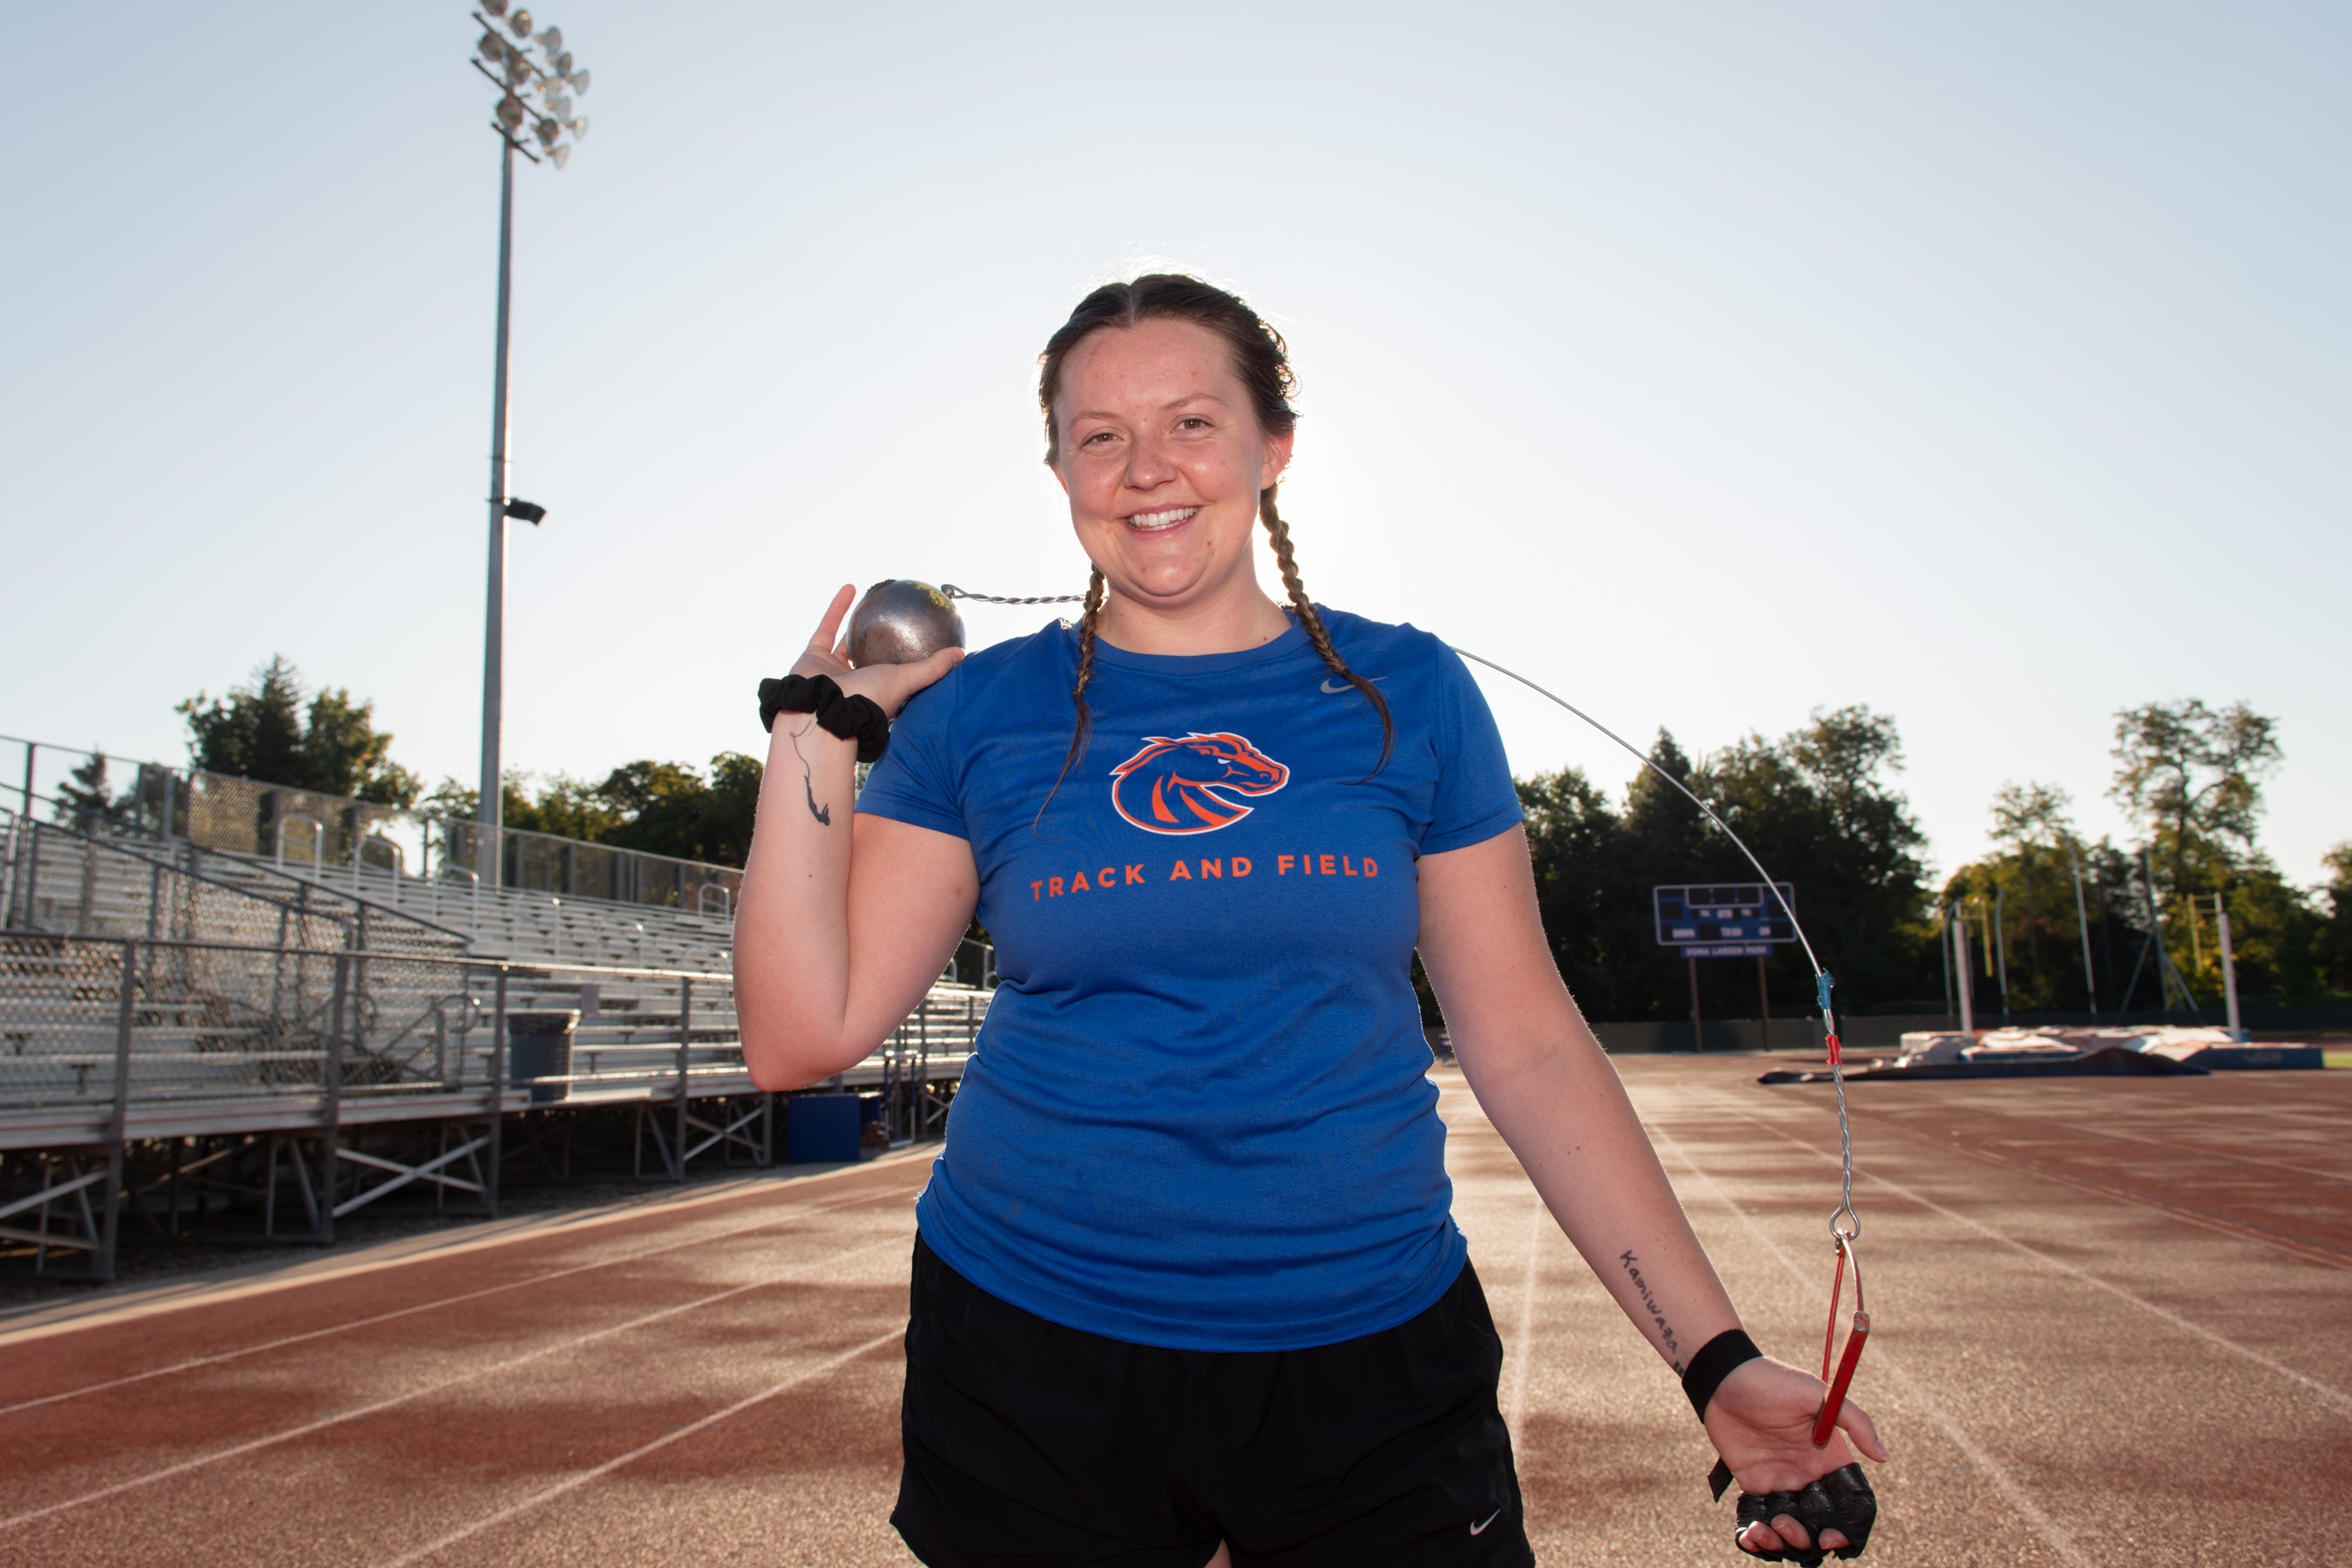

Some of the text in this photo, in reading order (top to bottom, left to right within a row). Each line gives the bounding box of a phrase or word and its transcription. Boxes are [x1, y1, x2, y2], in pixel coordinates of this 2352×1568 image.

[1031, 854, 1378, 901] TRACK AND FIELD
[1619, 1249, 1678, 1355] Kamiwaza
